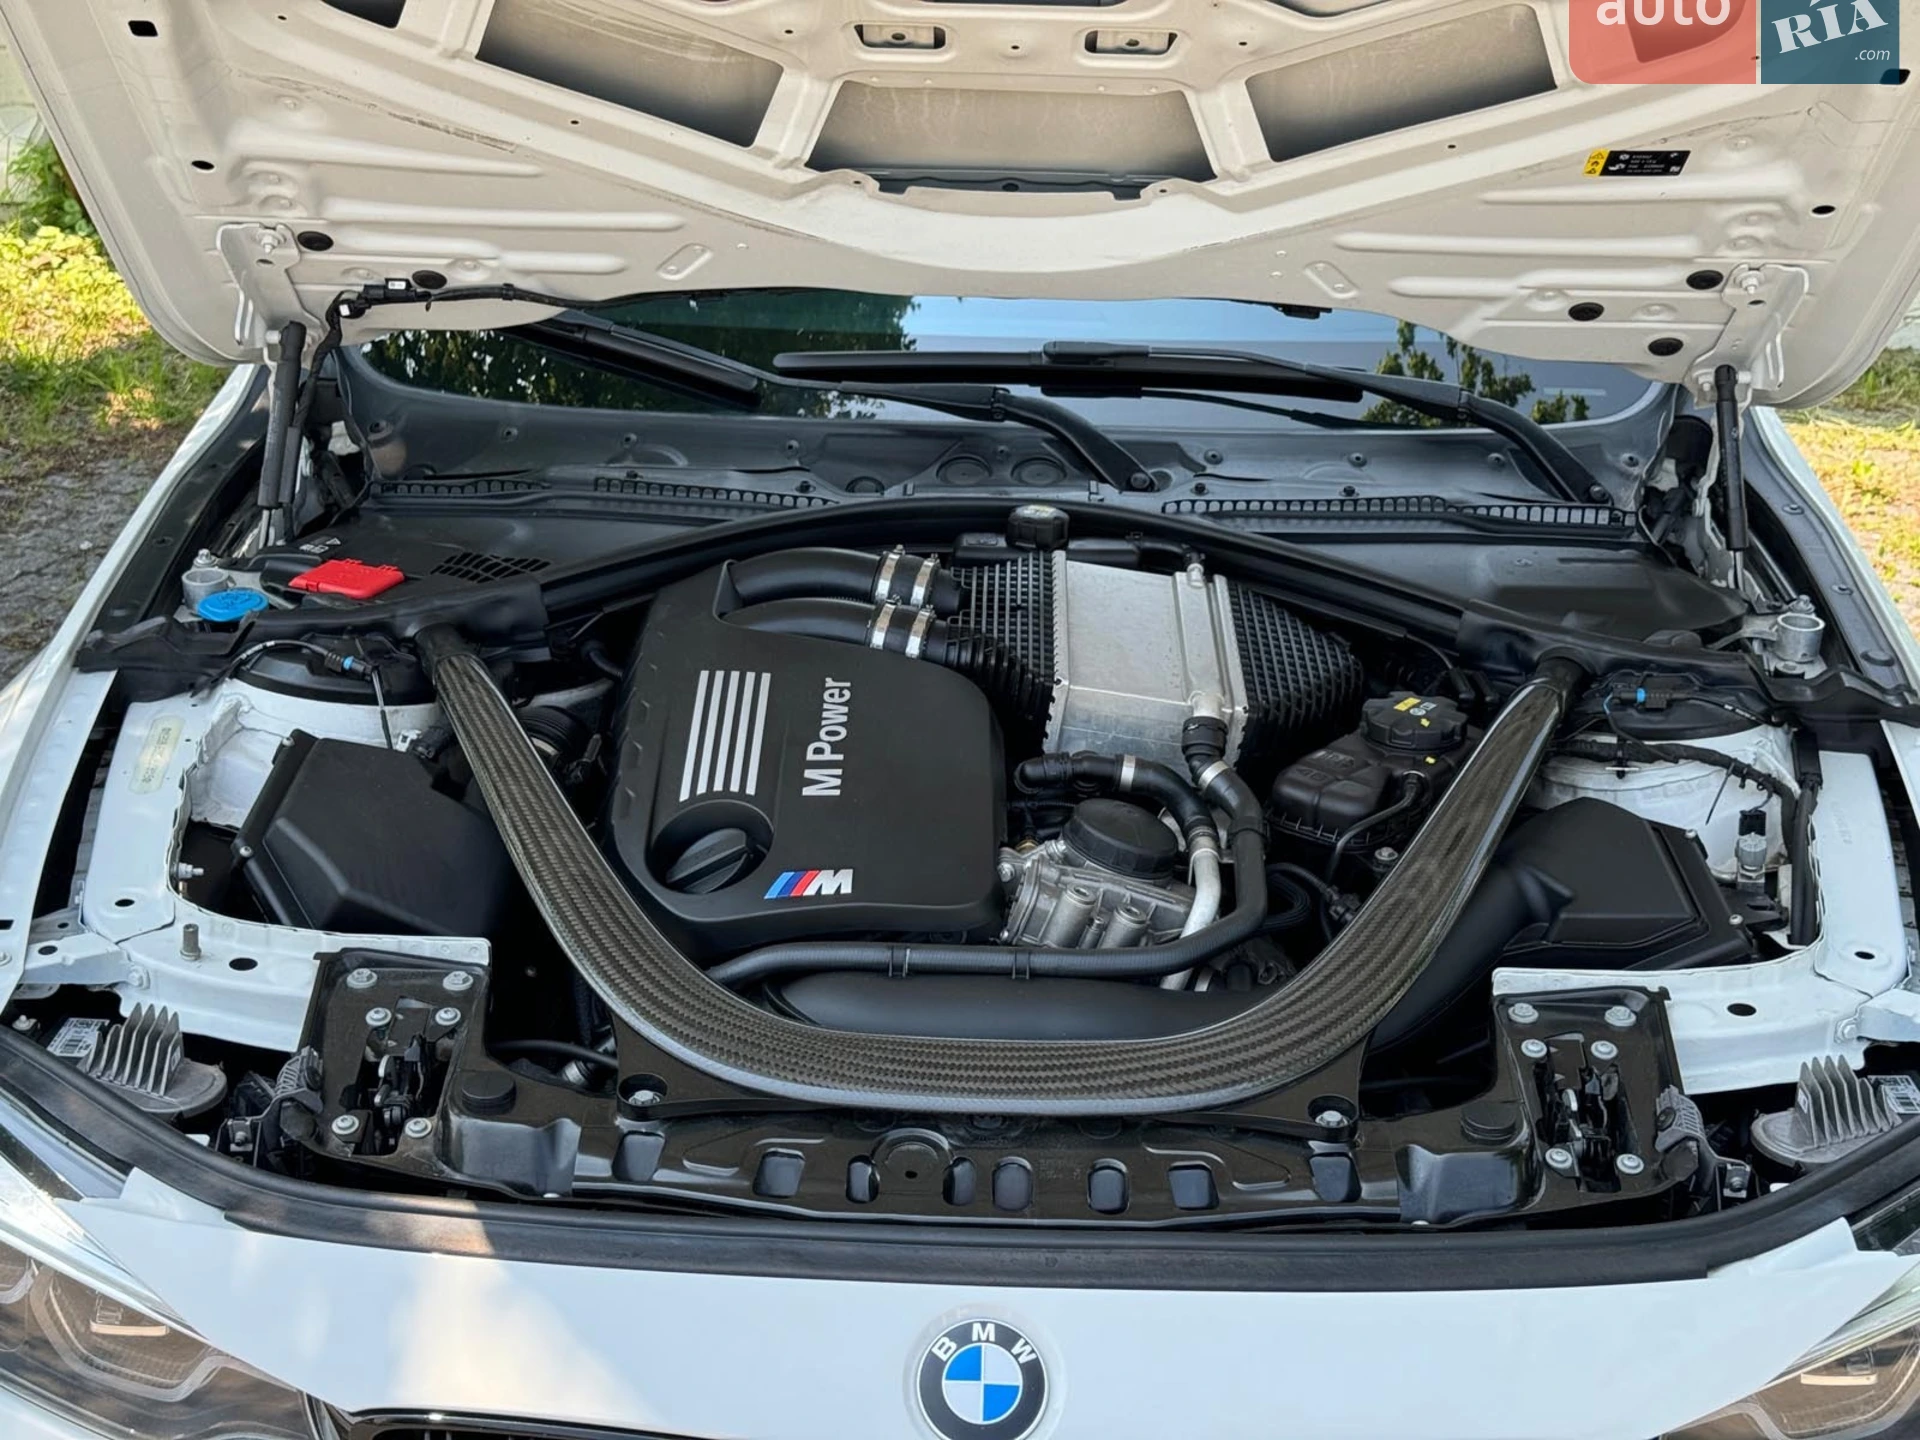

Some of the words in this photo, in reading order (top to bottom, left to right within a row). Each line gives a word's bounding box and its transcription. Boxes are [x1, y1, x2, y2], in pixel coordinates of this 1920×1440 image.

[806, 677, 852, 761] Power
[801, 768, 843, 796] M
[931, 1322, 1038, 1365] BMW
